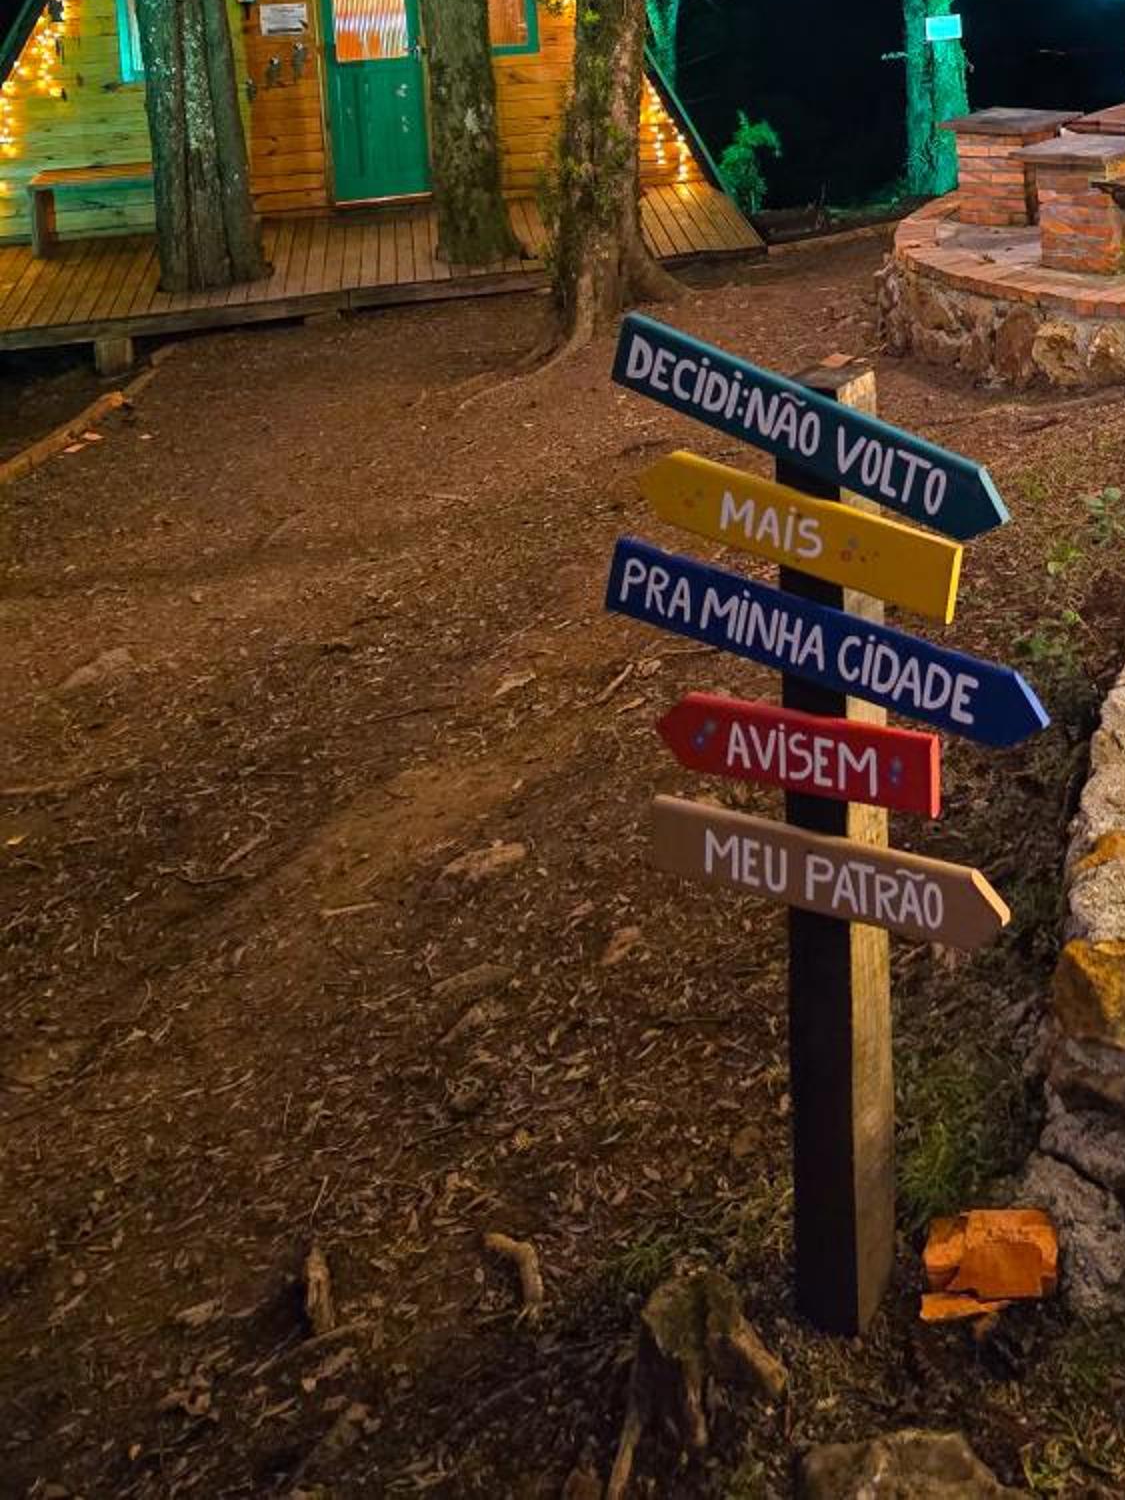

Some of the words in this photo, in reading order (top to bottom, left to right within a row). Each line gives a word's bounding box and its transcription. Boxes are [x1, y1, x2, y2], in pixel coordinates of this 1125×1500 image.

[837, 424, 947, 516] VOLTO
[619, 557, 691, 624] PRA
[699, 587, 825, 672] MINHA
[836, 634, 980, 725] CIDADE
[704, 828, 788, 893] MEU
[805, 852, 944, 930] PATRÃO
